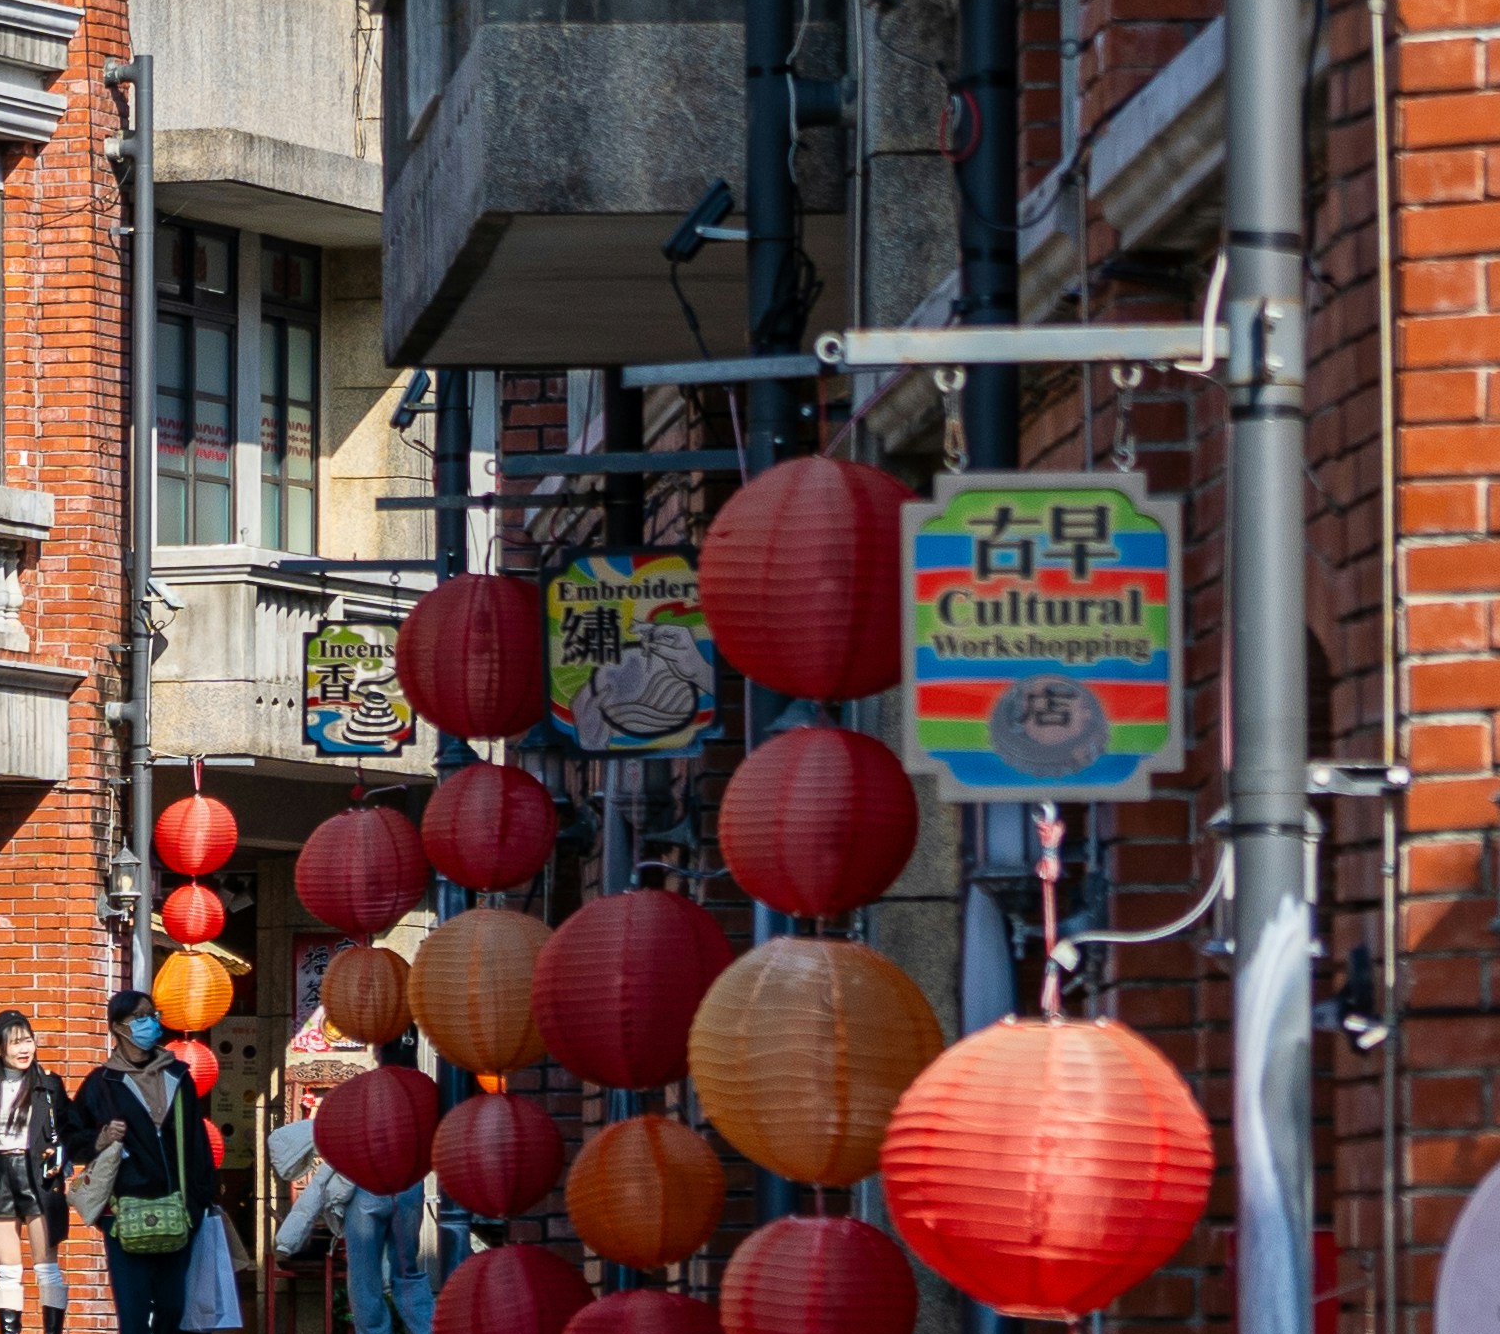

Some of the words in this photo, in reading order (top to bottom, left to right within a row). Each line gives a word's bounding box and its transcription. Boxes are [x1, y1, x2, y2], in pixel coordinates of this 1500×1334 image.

[969, 504, 1117, 580] 古早
[937, 589, 1145, 628] Cultural
[318, 640, 395, 658] Incens
[560, 607, 622, 665] 繡
[932, 633, 1152, 662] Workshopping
[315, 663, 355, 702] 香
[1022, 688, 1073, 727] 店
